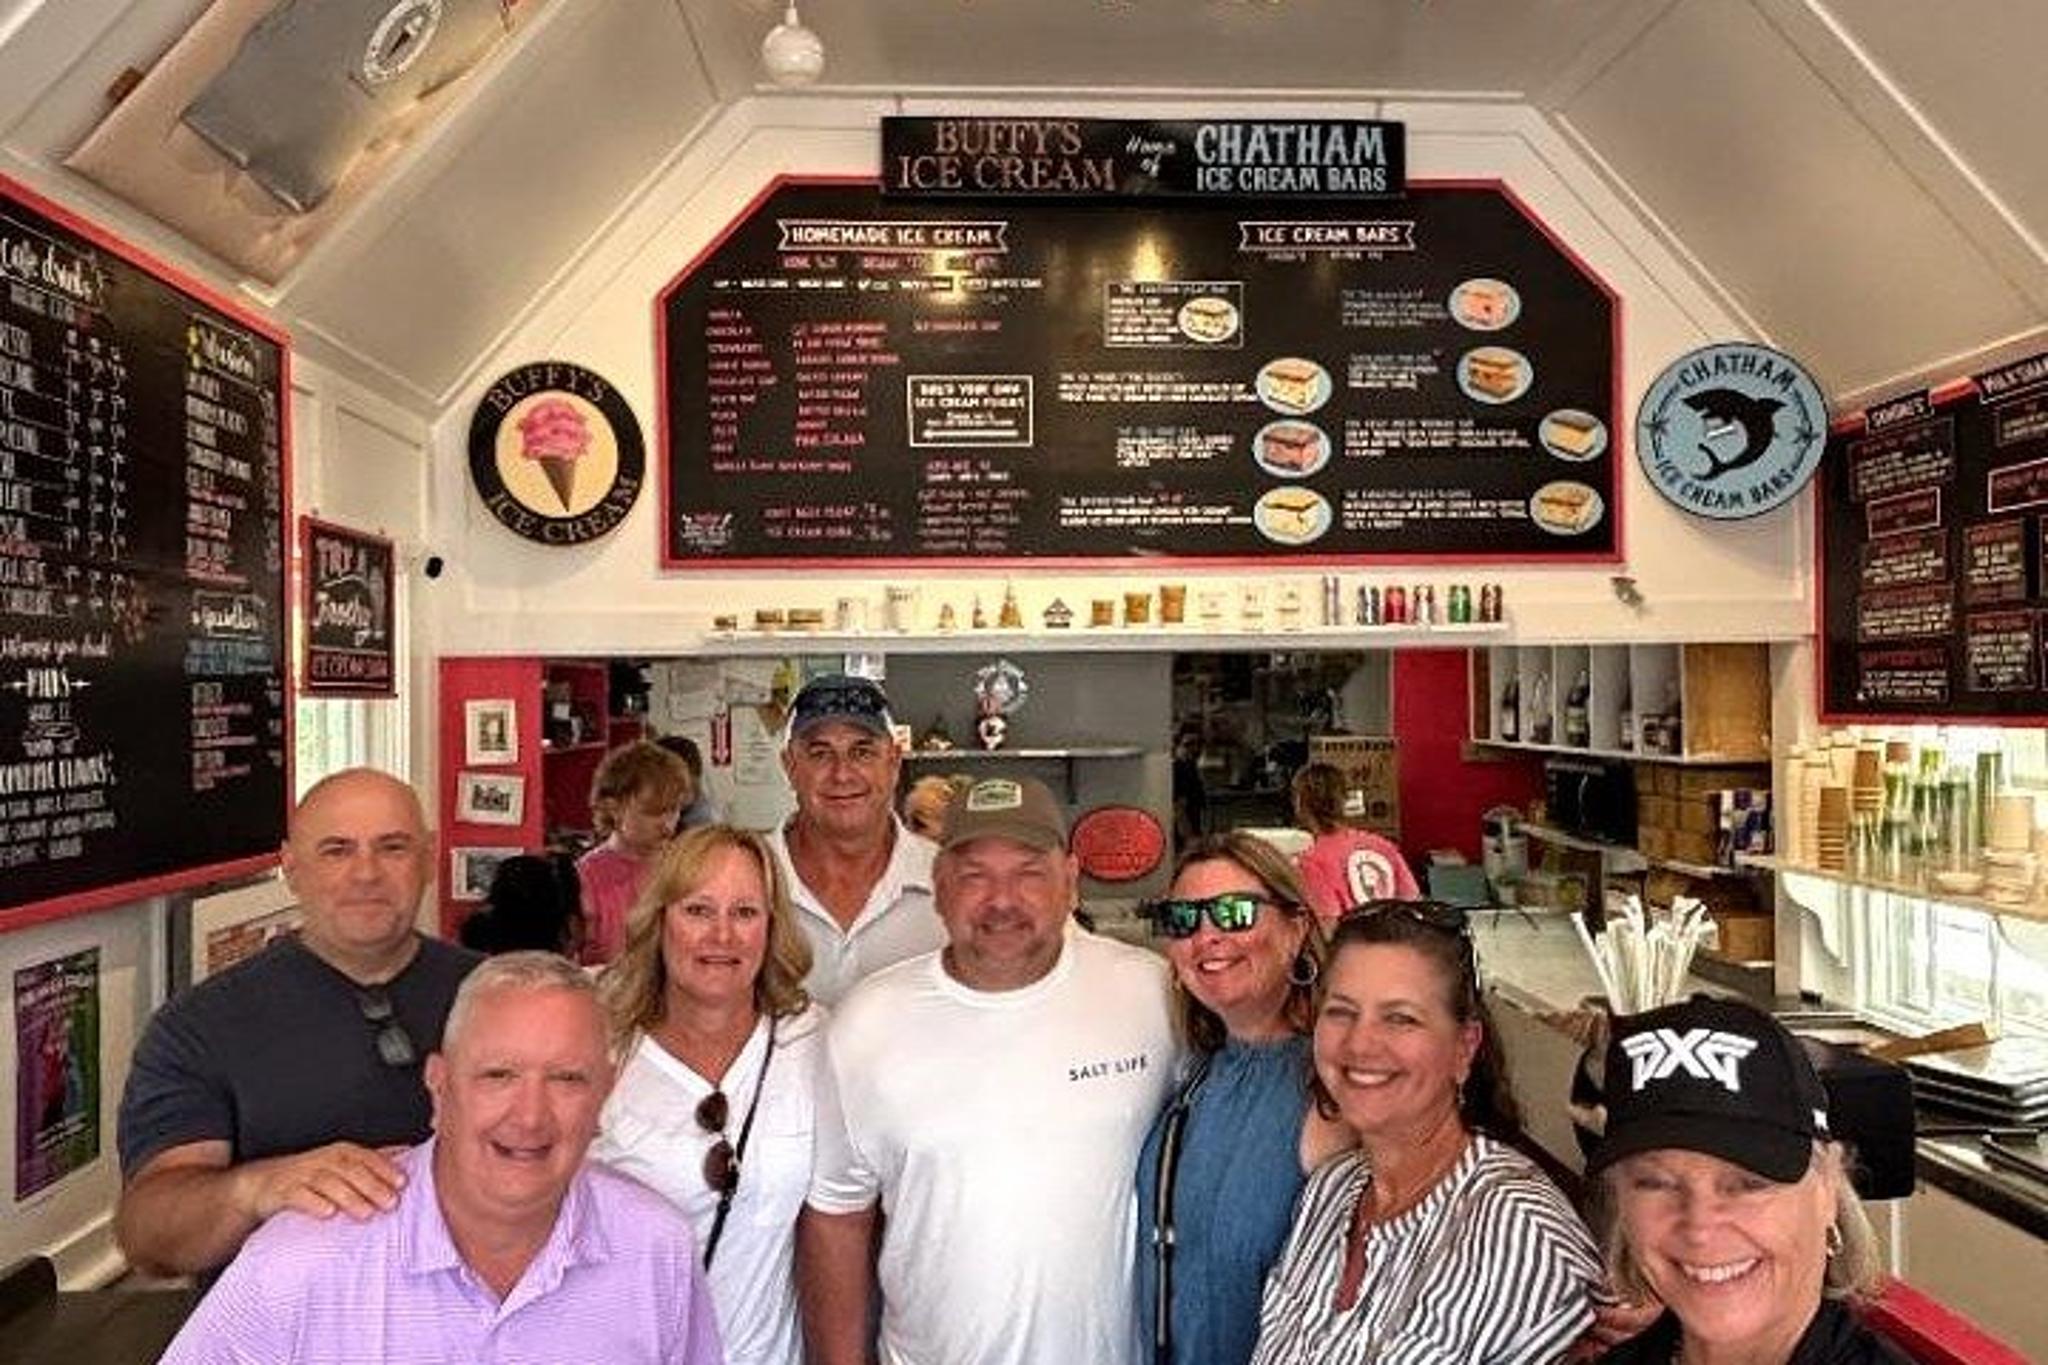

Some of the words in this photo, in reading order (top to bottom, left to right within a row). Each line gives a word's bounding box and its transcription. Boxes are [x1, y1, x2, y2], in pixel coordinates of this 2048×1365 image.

[934, 120, 1082, 155] BUFFY'S
[1195, 124, 1387, 166] CHATHAM
[899, 156, 963, 190] ICE
[975, 157, 1117, 191] CREAM
[1197, 167, 1234, 191] ICE
[1239, 167, 1320, 192] CREAM
[1327, 167, 1386, 191] BARS
[793, 227, 889, 243] HOMEMADE
[898, 229, 926, 243] ICE
[933, 230, 993, 244] CREAM
[1258, 227, 1287, 242] ICE
[1294, 227, 1350, 243] CREAM
[1356, 227, 1400, 243] BARS
[489, 365, 607, 415] BUFFY'S
[1678, 353, 1797, 393] CHATHAM
[1655, 459, 1684, 487] ICE
[1680, 482, 1744, 510] CREAM
[1749, 467, 1795, 505] BARS
[487, 492, 538, 534] ICE
[544, 475, 637, 541] CREAM
[1069, 1063, 1107, 1081] SALT
[1115, 1055, 1146, 1073] LIFE
[1621, 1029, 1757, 1090] PXG
